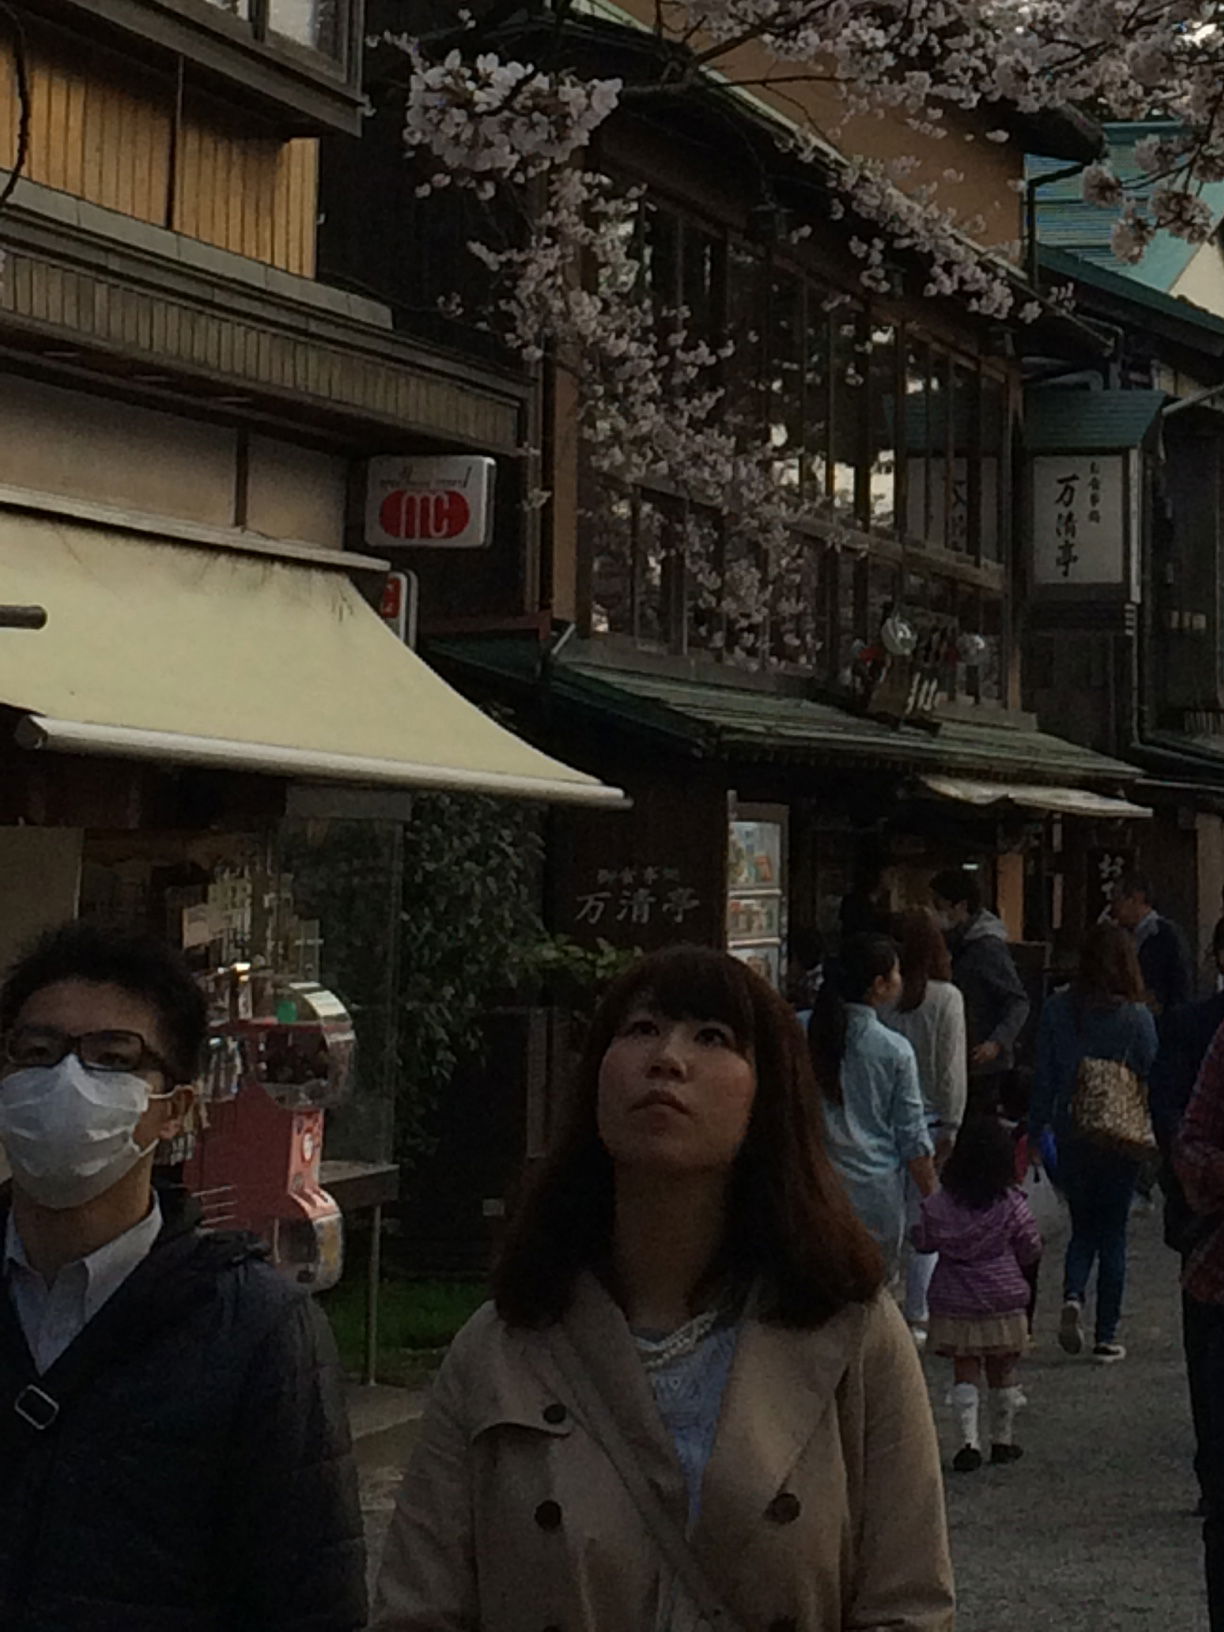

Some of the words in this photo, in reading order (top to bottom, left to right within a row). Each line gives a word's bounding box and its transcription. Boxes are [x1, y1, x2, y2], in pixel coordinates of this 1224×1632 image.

[1055, 474, 1079, 577] 万清亭
[574, 888, 700, 925] 万清亭
